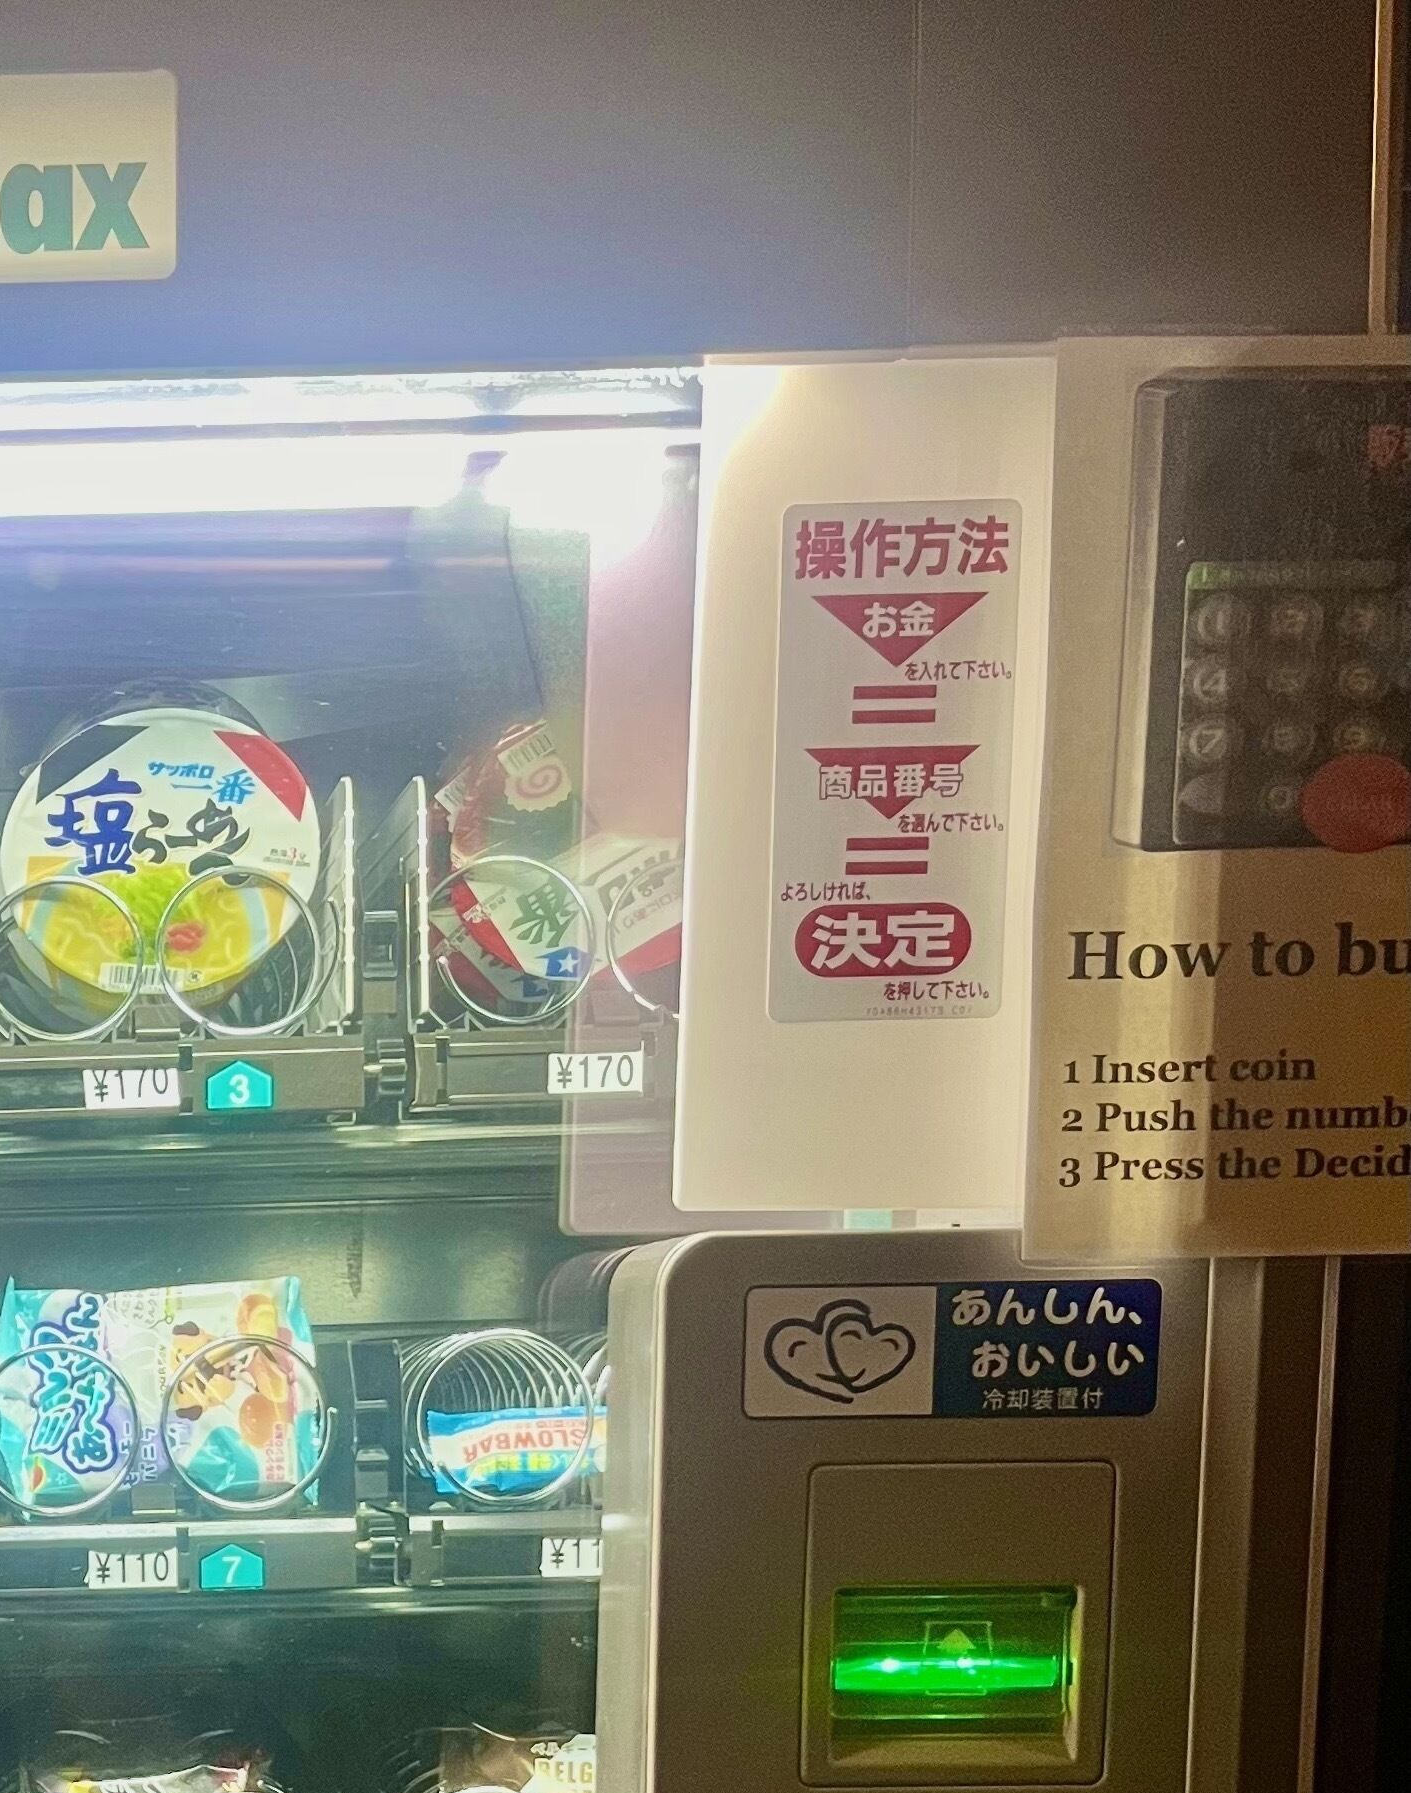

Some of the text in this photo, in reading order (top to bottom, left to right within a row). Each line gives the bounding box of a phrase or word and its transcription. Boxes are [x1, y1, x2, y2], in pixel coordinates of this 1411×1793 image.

[794, 515, 1010, 580] 操作方法
[862, 600, 936, 639] お金
[904, 660, 1012, 682] を入れて下さい。
[147, 760, 256, 806] サッポロ一番
[818, 763, 964, 800] 商品番号
[43, 768, 252, 887] 塩らーめん
[897, 813, 1004, 834] を選んで下さい。
[780, 882, 871, 903] よろしければ、
[810, 911, 957, 972] 決定
[1067, 930, 1231, 983] How
[1249, 931, 1317, 980] to
[882, 981, 990, 1001] を押して下さい。
[91, 1069, 170, 1103] ¥170
[555, 1053, 635, 1091] ¥170
[1063, 1053, 1318, 1085] 1 Insert coin
[228, 1074, 251, 1105] 3
[1060, 1098, 1411, 1134] 2 Push the numb
[1058, 1160, 1083, 1190] 3
[1093, 1151, 1206, 1184] Press
[1216, 1150, 1282, 1180] the
[951, 1287, 1143, 1327] あんしん、
[971, 1340, 1145, 1379] おいしい
[982, 1386, 1105, 1411] 冷却装置付
[96, 1552, 169, 1585] ¥110
[221, 1555, 242, 1584] 7
